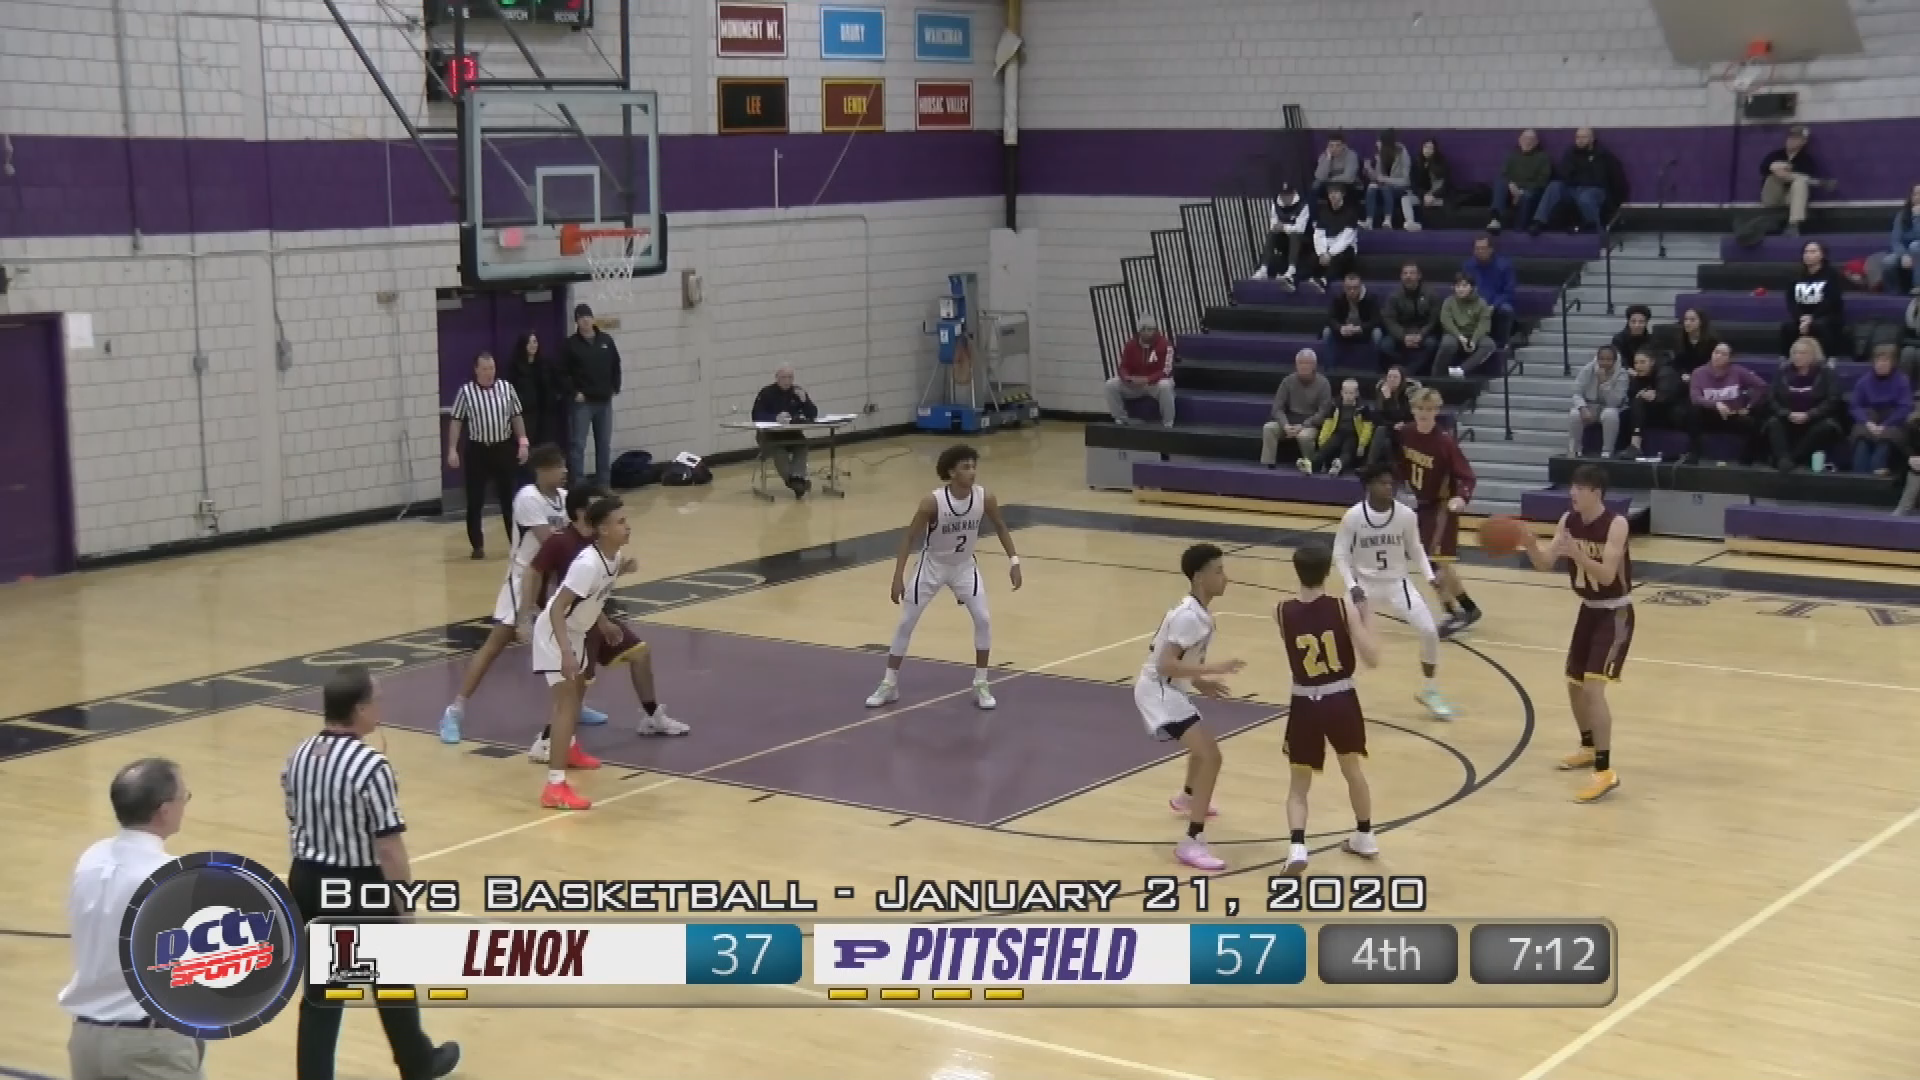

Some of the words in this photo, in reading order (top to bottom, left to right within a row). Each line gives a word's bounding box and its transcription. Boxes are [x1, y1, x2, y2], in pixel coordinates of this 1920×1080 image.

[746, 96, 762, 114] LEE
[955, 535, 967, 552] 2
[1376, 550, 1387, 570] 5
[1295, 630, 1343, 678] 21
